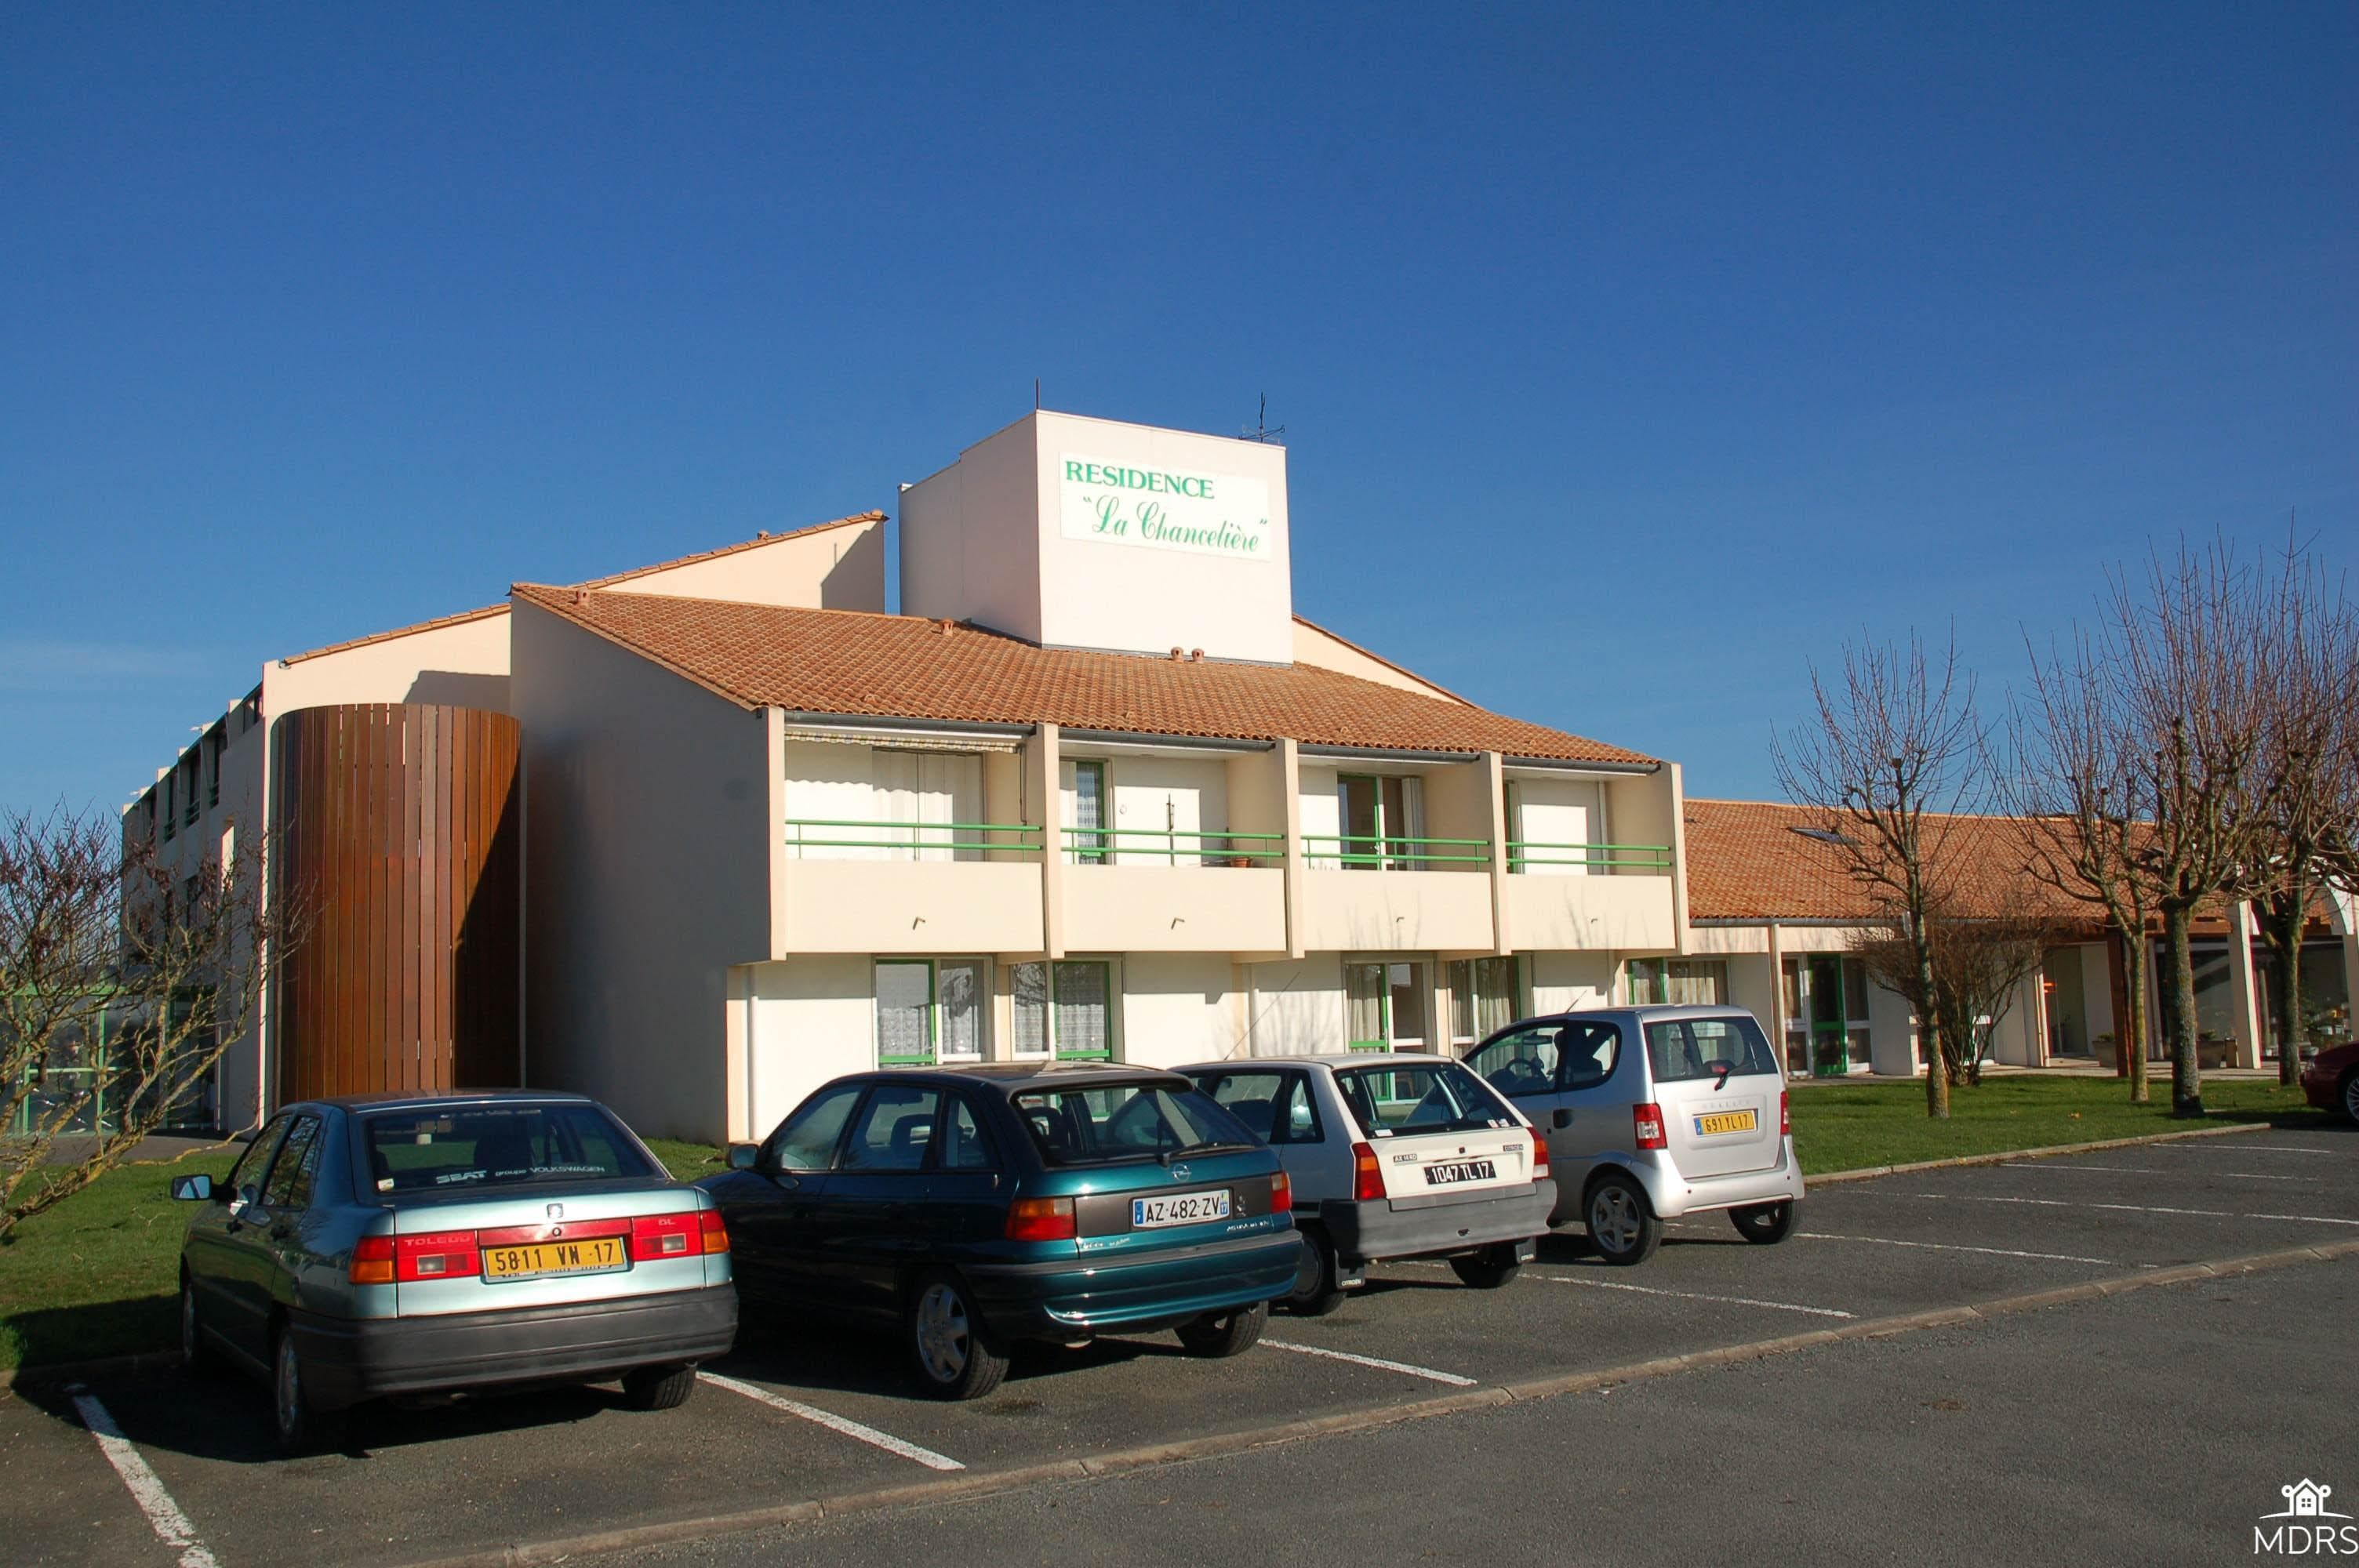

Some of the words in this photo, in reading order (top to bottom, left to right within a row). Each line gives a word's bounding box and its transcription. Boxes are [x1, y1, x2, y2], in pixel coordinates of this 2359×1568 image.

[1065, 460, 1215, 499] RESIDENCE
[1705, 1117, 1723, 1132] 691
[1725, 1116, 1736, 1130] YL
[1738, 1114, 1748, 1128] 17
[436, 1171, 487, 1185] SEAT
[530, 1165, 605, 1174] VOLKSWAGEN
[1431, 1165, 1459, 1184] 1047
[1462, 1163, 1477, 1181] TL
[1477, 1161, 1489, 1178] 17
[405, 1236, 471, 1247] TOLEDO
[495, 1248, 543, 1272] 5811
[594, 1243, 613, 1262] 17
